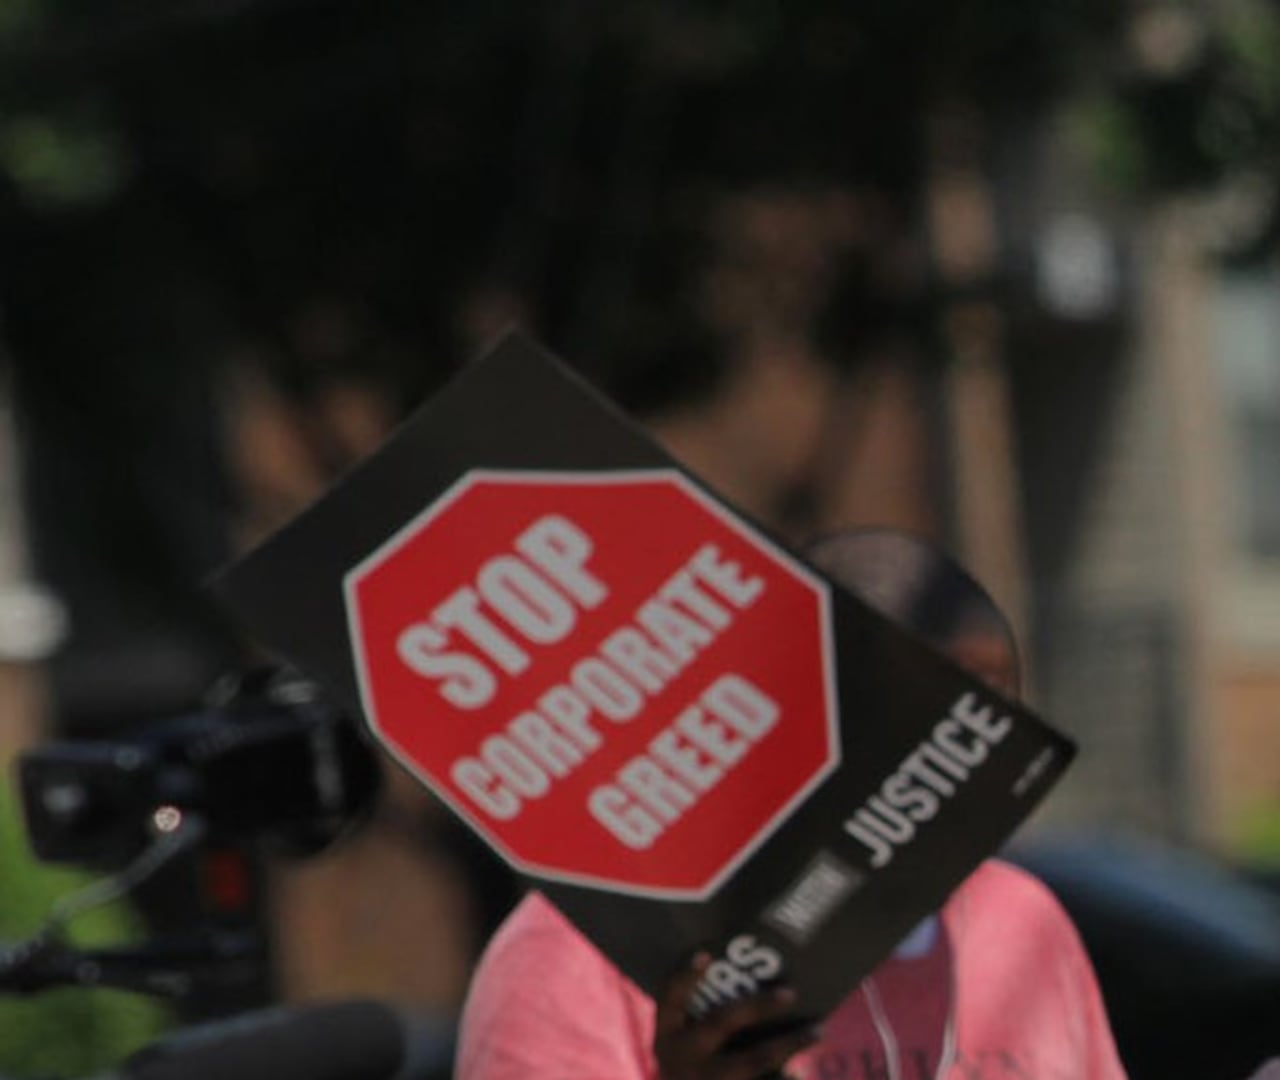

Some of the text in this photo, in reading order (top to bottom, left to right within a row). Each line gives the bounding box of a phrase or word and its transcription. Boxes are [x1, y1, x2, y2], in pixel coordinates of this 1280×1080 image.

[396, 515, 608, 709] STOP
[450, 544, 764, 820] CORPORATE
[587, 674, 780, 850] GREED
[844, 692, 1013, 868] JUSTICE
